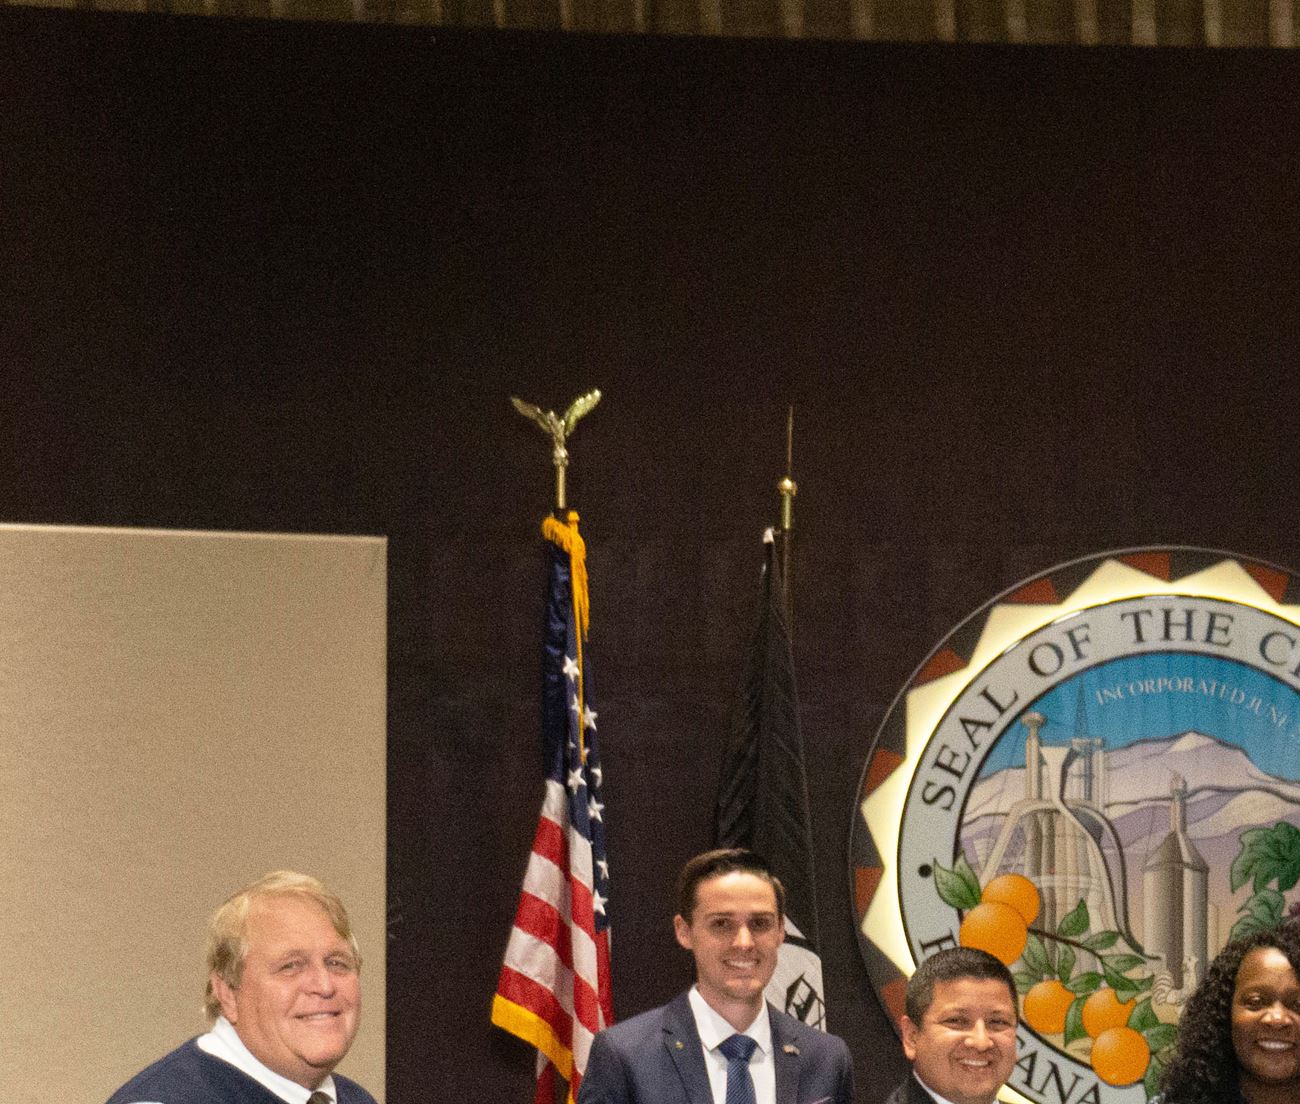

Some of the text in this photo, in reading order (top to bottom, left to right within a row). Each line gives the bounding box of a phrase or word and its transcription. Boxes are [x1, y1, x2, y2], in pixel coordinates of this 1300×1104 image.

[923, 684, 1020, 812] SEAL
[1028, 623, 1094, 678] OF
[1121, 607, 1236, 648] THE
[1095, 677, 1245, 705] INCORPORATED
